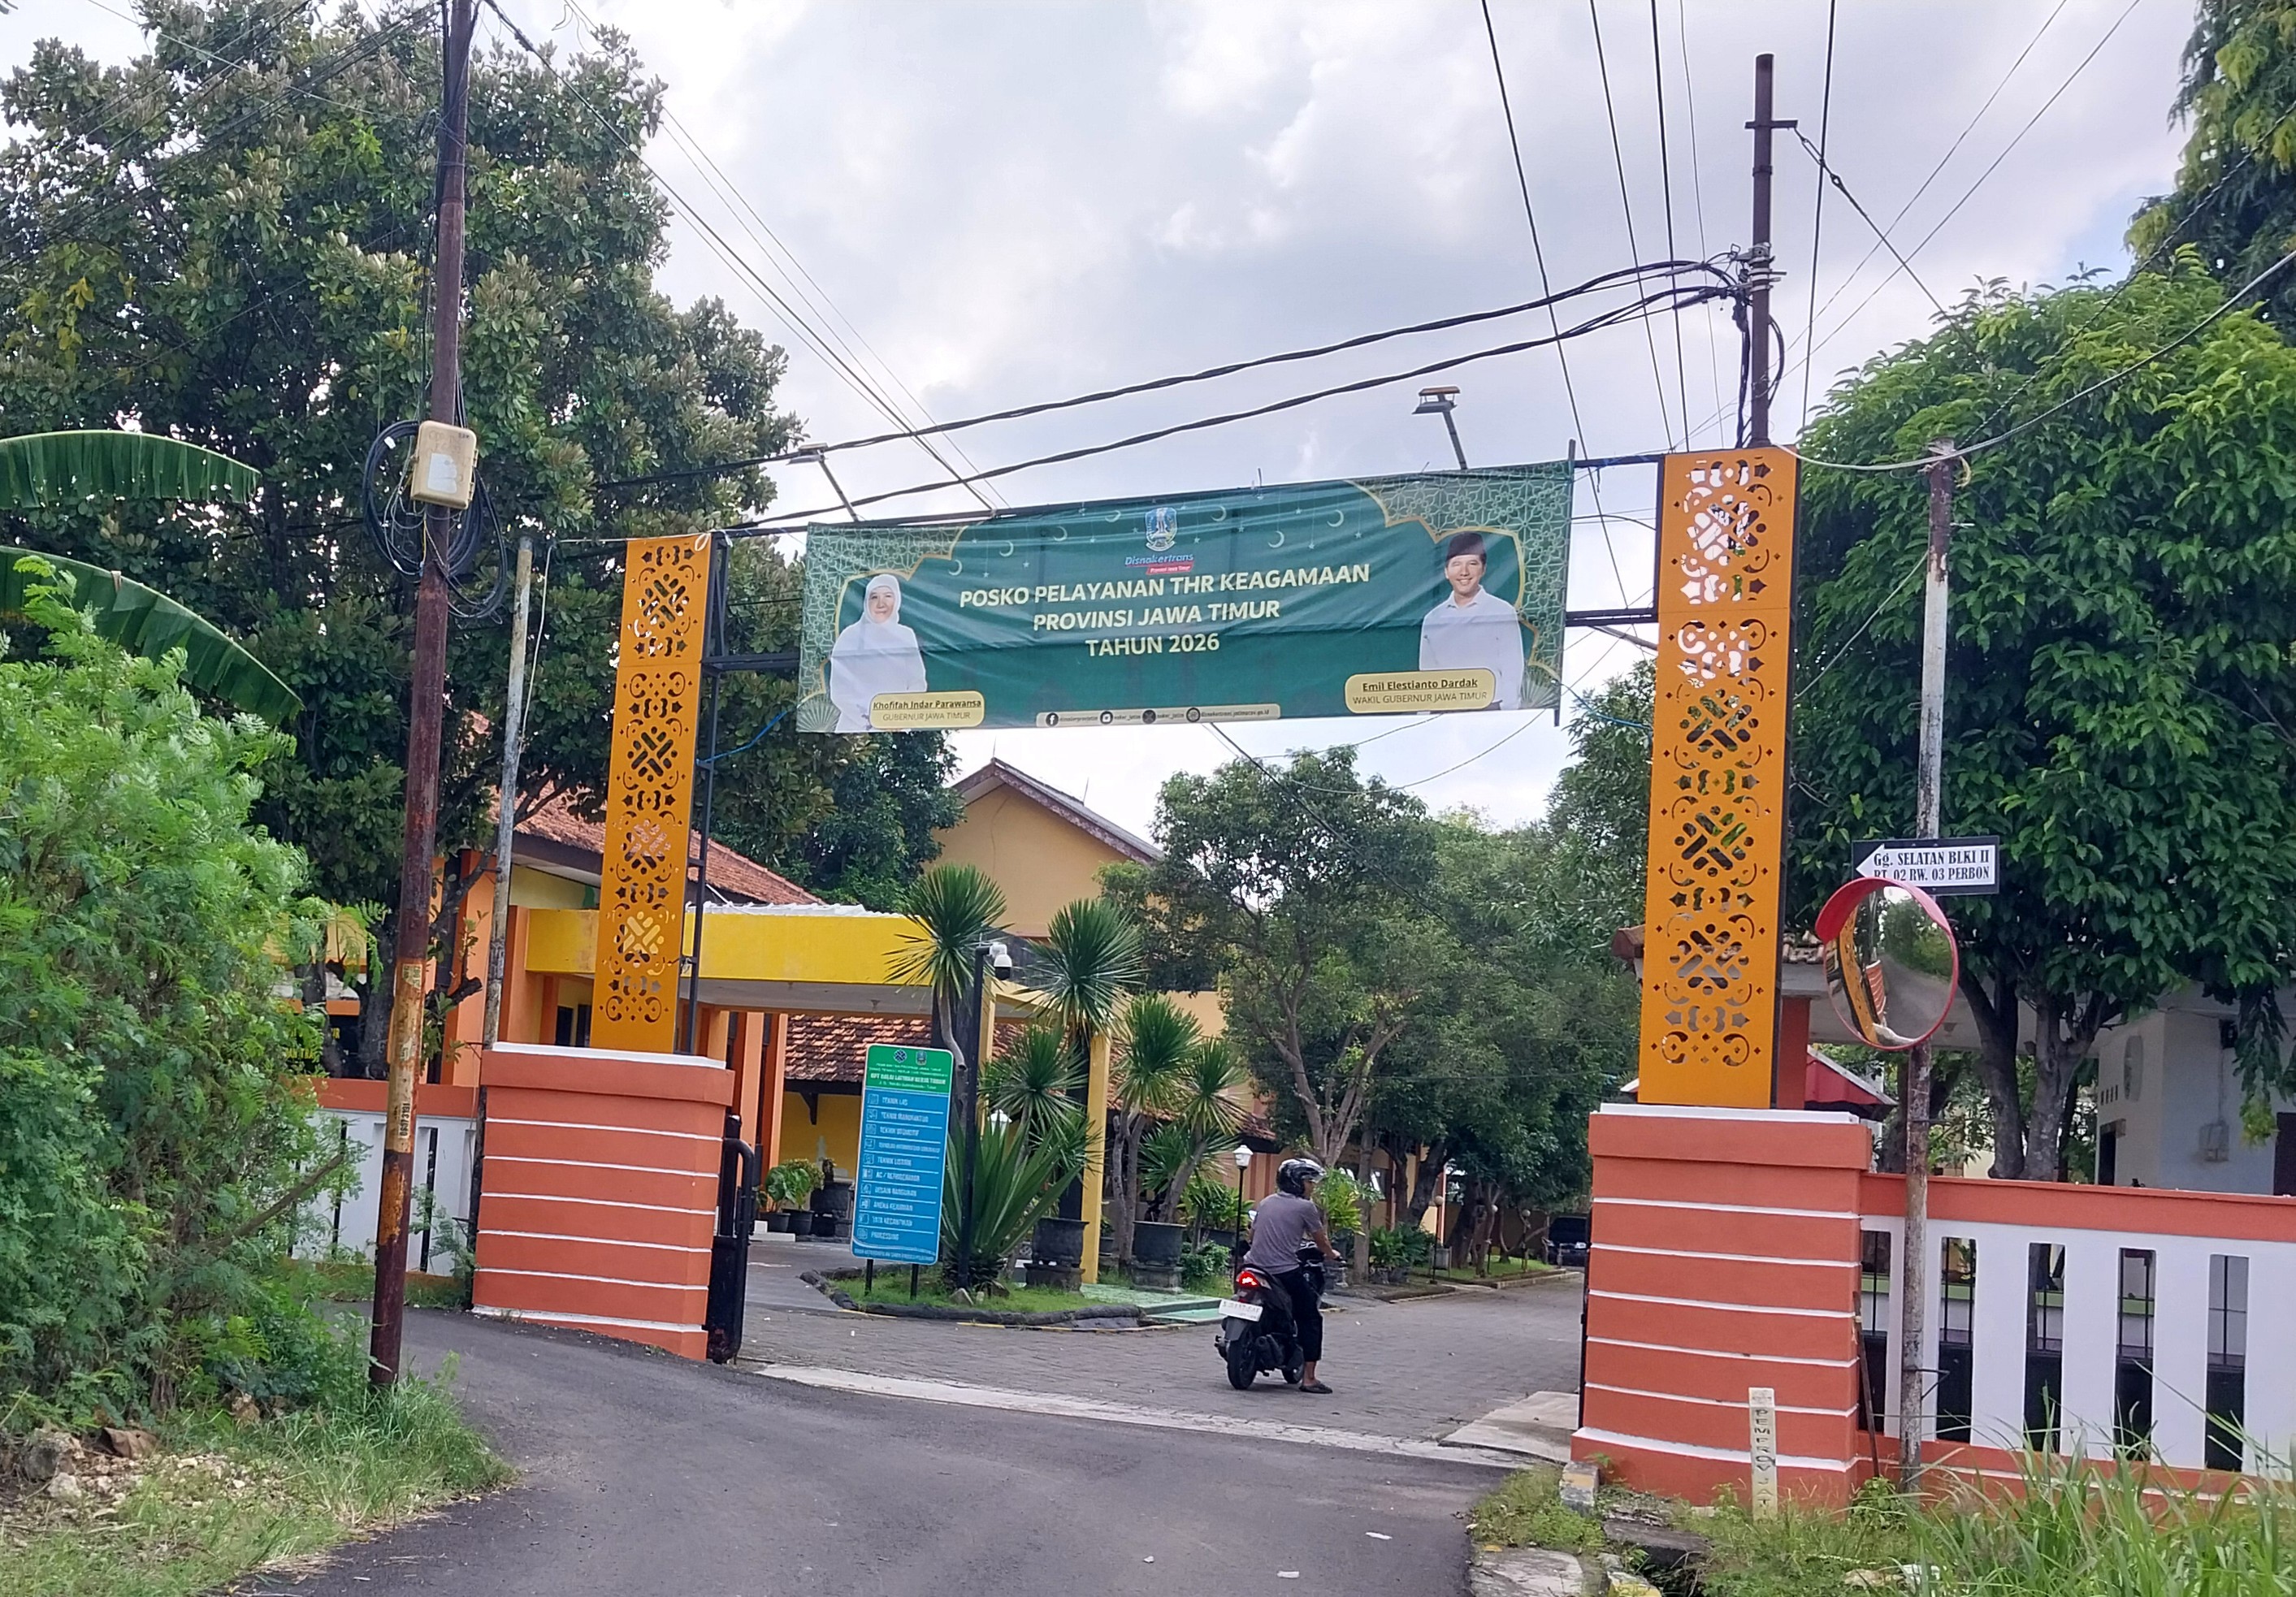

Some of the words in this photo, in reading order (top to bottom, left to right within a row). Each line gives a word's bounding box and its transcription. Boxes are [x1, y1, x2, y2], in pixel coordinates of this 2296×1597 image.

[1125, 553, 1193, 565] Disnakertrans
[960, 586, 1029, 608] POSKO
[1034, 580, 1164, 604] PELAYANAN
[1169, 575, 1215, 595] THR
[1219, 564, 1370, 592] KEAGAMAAN
[1033, 609, 1133, 631] PROVINSI
[1137, 606, 1202, 627] JAWA
[1207, 600, 1280, 622] TIMUR
[1085, 635, 1163, 657] TAHUN
[1169, 633, 1220, 653] 2026
[1362, 682, 1384, 692] Emil
[1388, 679, 1438, 690] Elestianto
[1441, 678, 1478, 689] Dardak
[910, 700, 933, 709] Indar
[935, 699, 981, 708] Parawansa
[1353, 696, 1380, 704] WAKIL
[1383, 694, 1432, 703] GUBERNUR
[1433, 693, 1457, 703] JAWA
[1460, 691, 1488, 701] TIMUR
[882, 713, 924, 721] GUBERNUR
[925, 712, 945, 721] JAWA
[947, 712, 971, 720] TIMUR
[1874, 853, 1893, 868] Gg.
[1898, 850, 1945, 866] SELATAN
[1948, 850, 1976, 863] BLKI
[1980, 850, 1989, 863] II
[1894, 869, 1906, 881] 02
[1909, 868, 1928, 881] RW.
[1932, 868, 1944, 881] 03
[1948, 867, 1990, 880] PERBON
